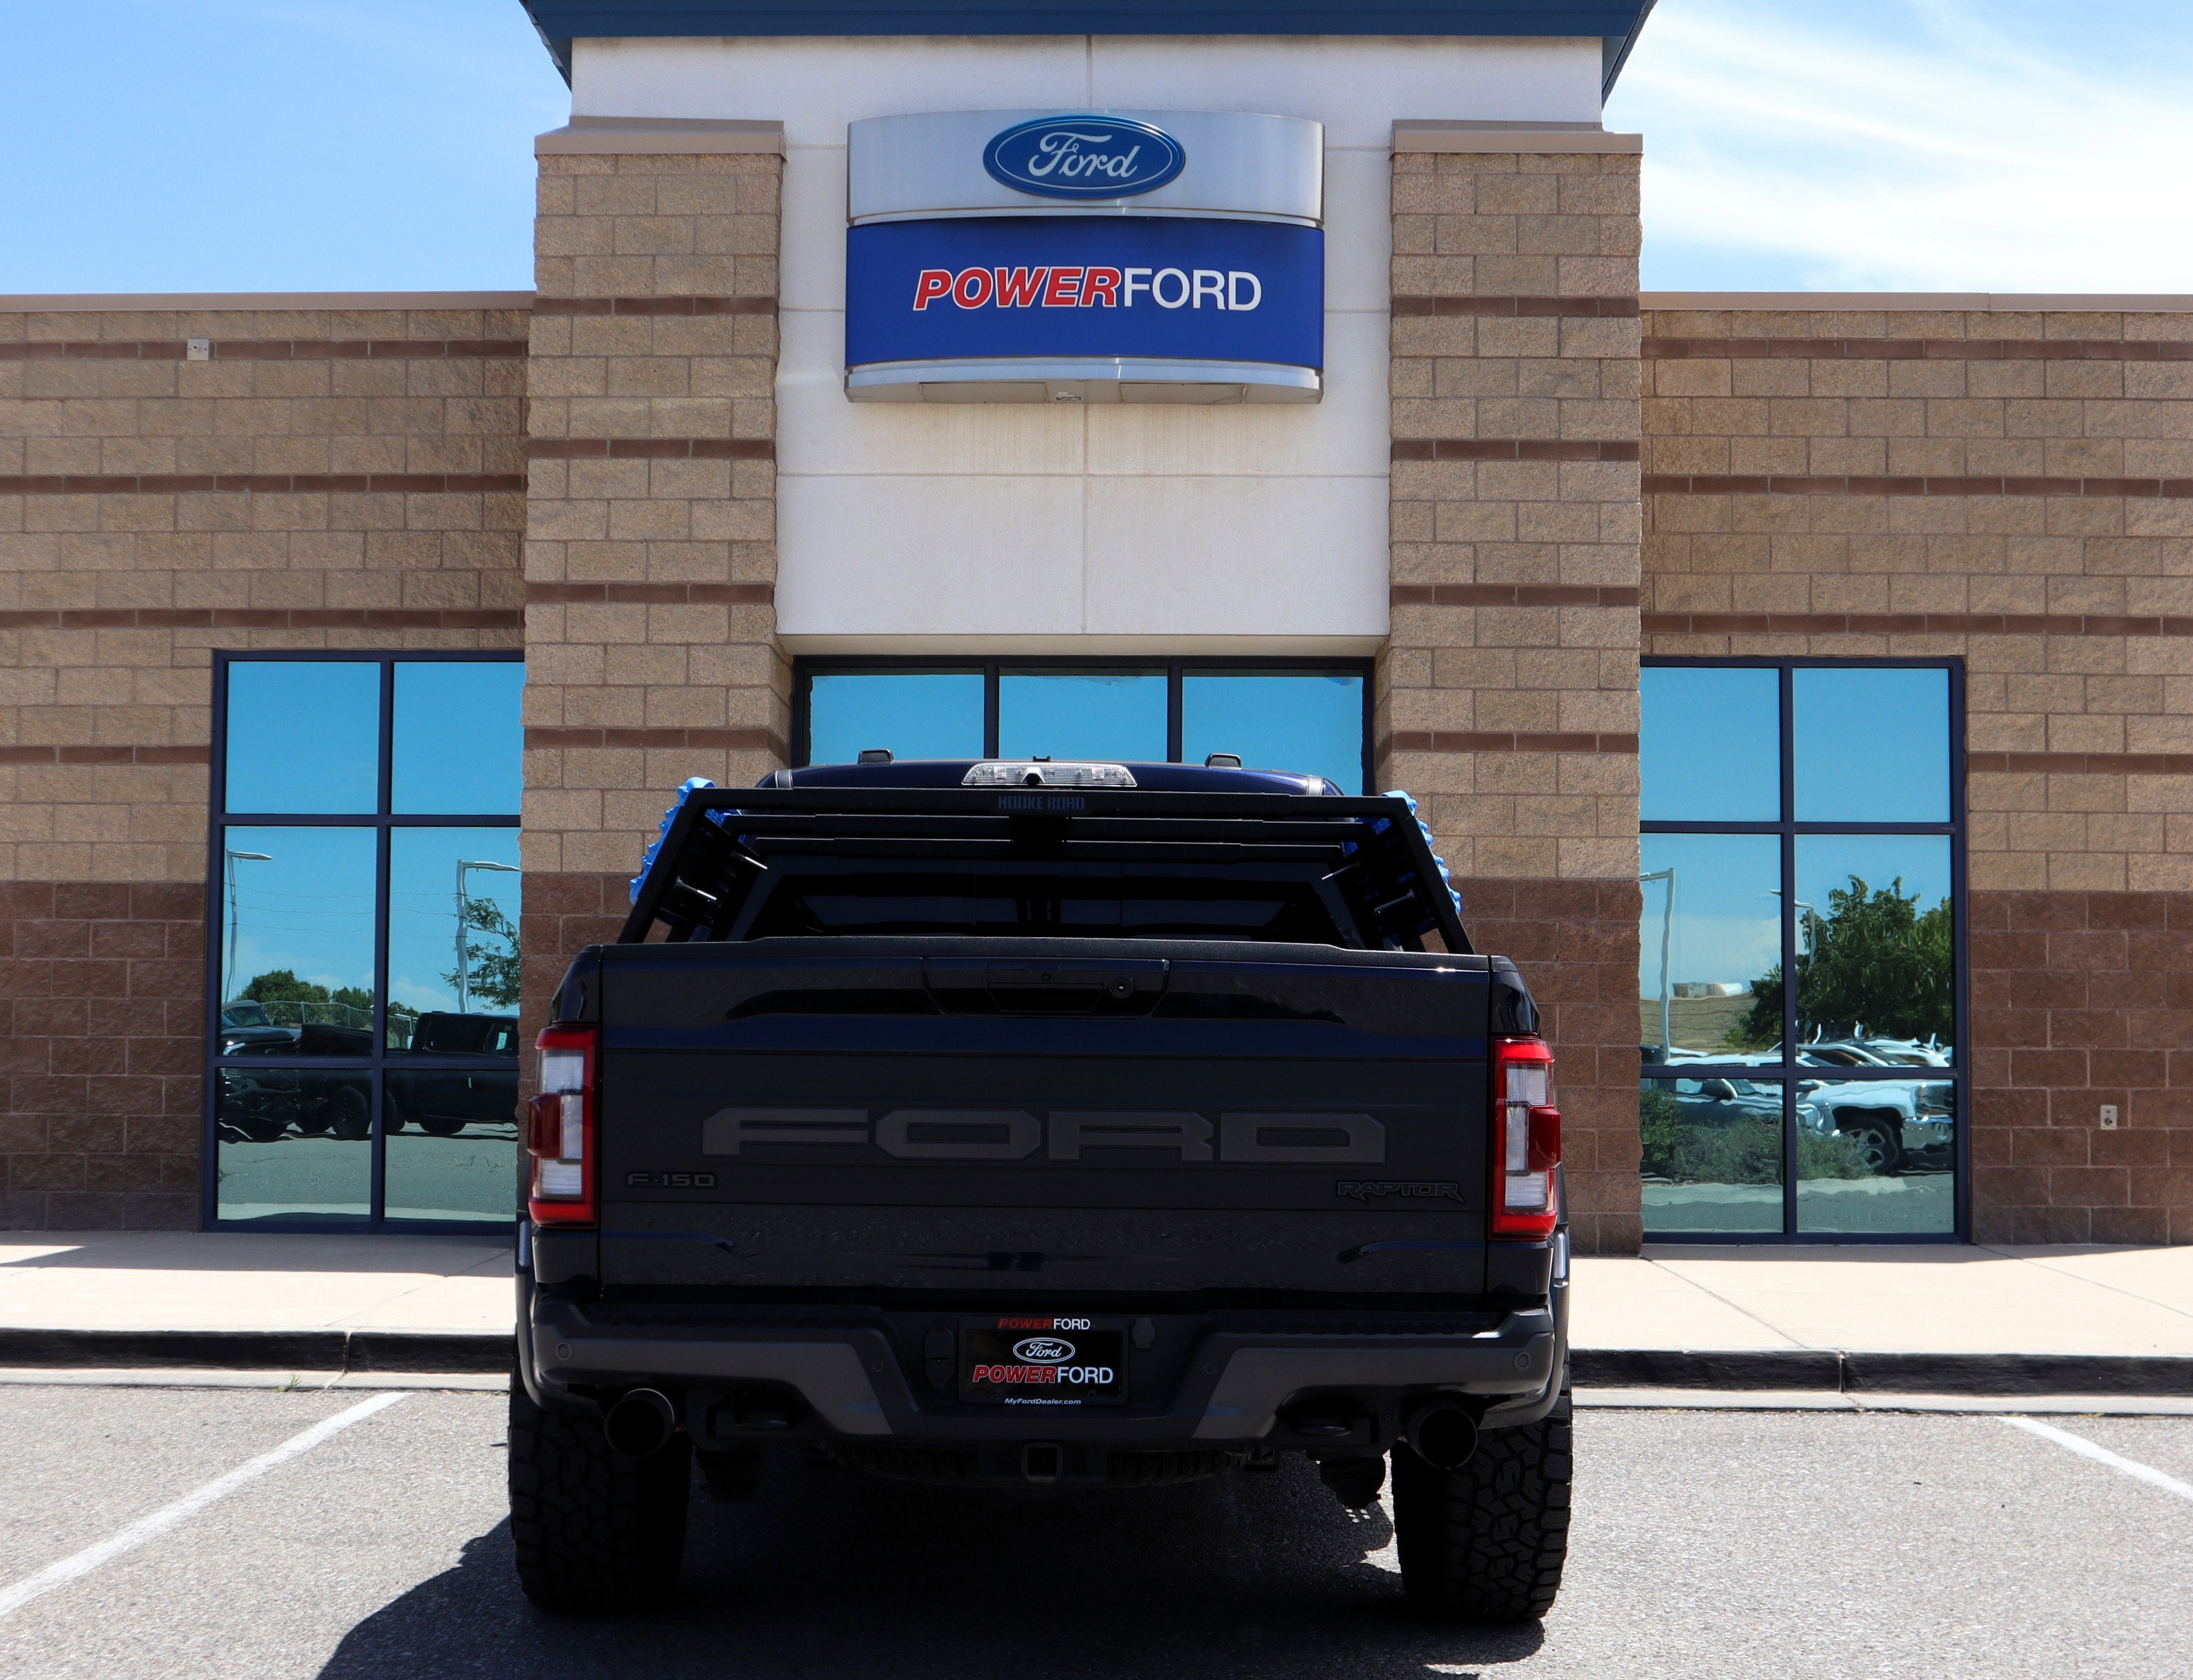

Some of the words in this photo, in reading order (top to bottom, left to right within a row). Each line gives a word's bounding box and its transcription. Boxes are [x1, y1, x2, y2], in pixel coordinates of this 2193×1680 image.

[1027, 132, 1140, 178] Ford
[1047, 796, 1085, 810] ROAD
[700, 1104, 1387, 1164] FORD
[627, 1173, 714, 1187] F-150
[1337, 1181, 1466, 1204] RAPTOR
[1025, 1341, 1062, 1357] Ford
